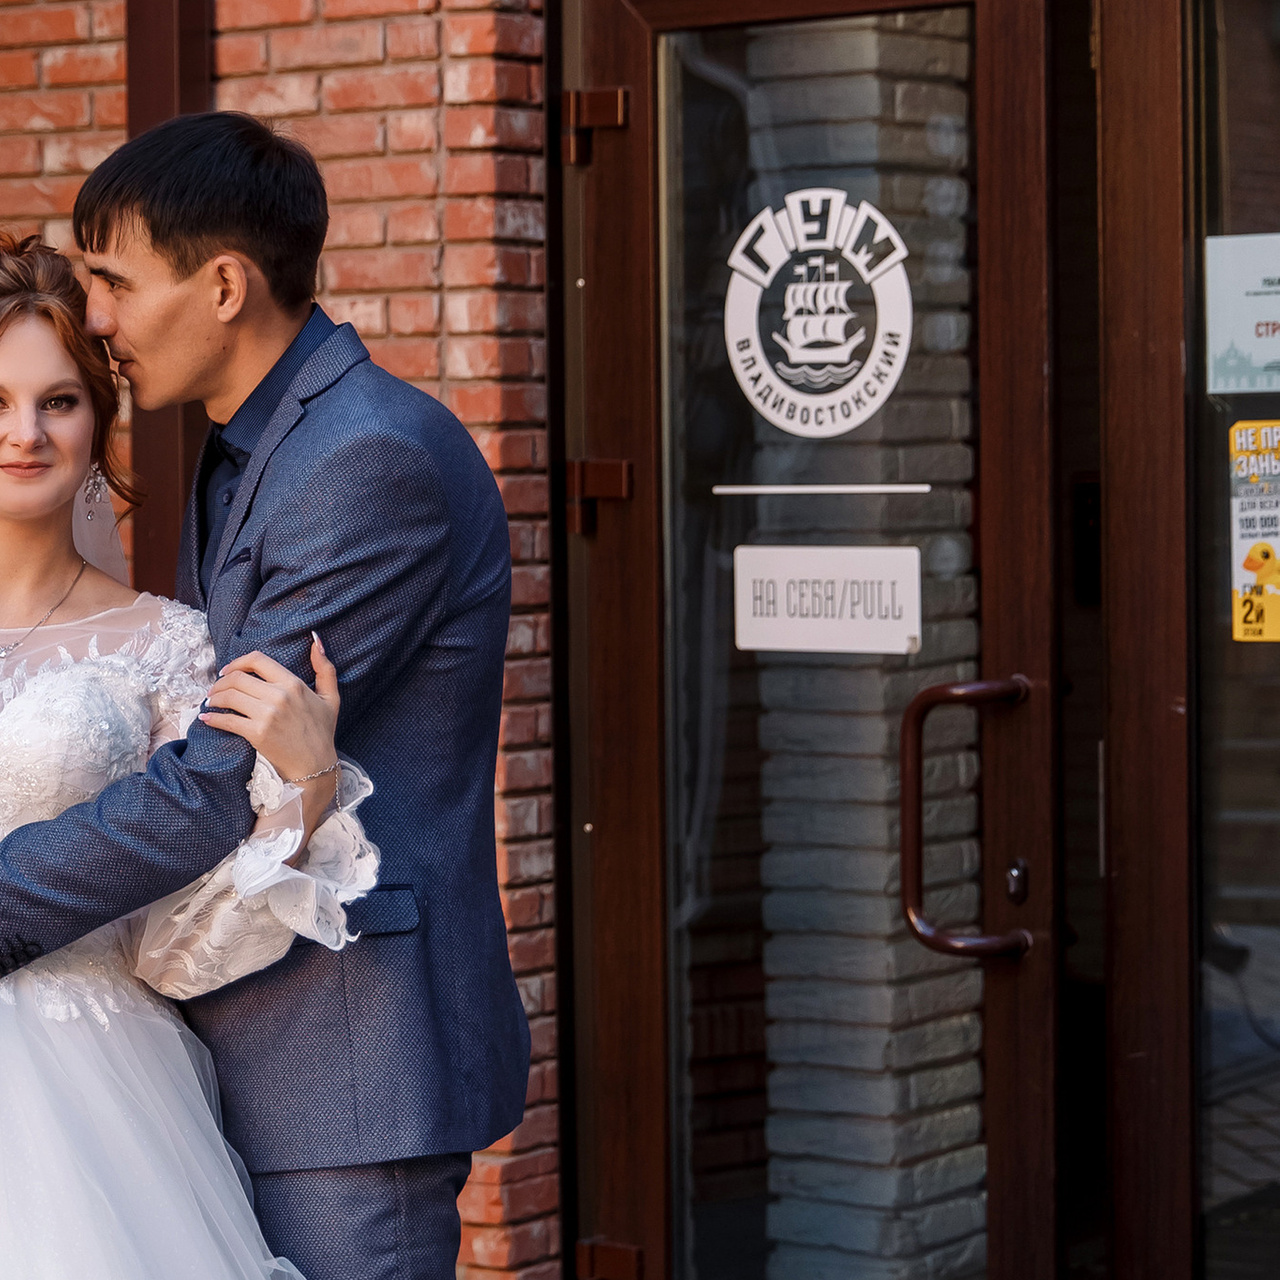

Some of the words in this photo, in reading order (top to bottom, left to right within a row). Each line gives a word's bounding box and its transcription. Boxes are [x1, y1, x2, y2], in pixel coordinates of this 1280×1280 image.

[742, 198, 897, 274] ГУМ
[735, 330, 902, 426] ВЛАДИВОСТОКСКИЙ
[1235, 428, 1258, 451] НЕ
[751, 578, 778, 618] НА
